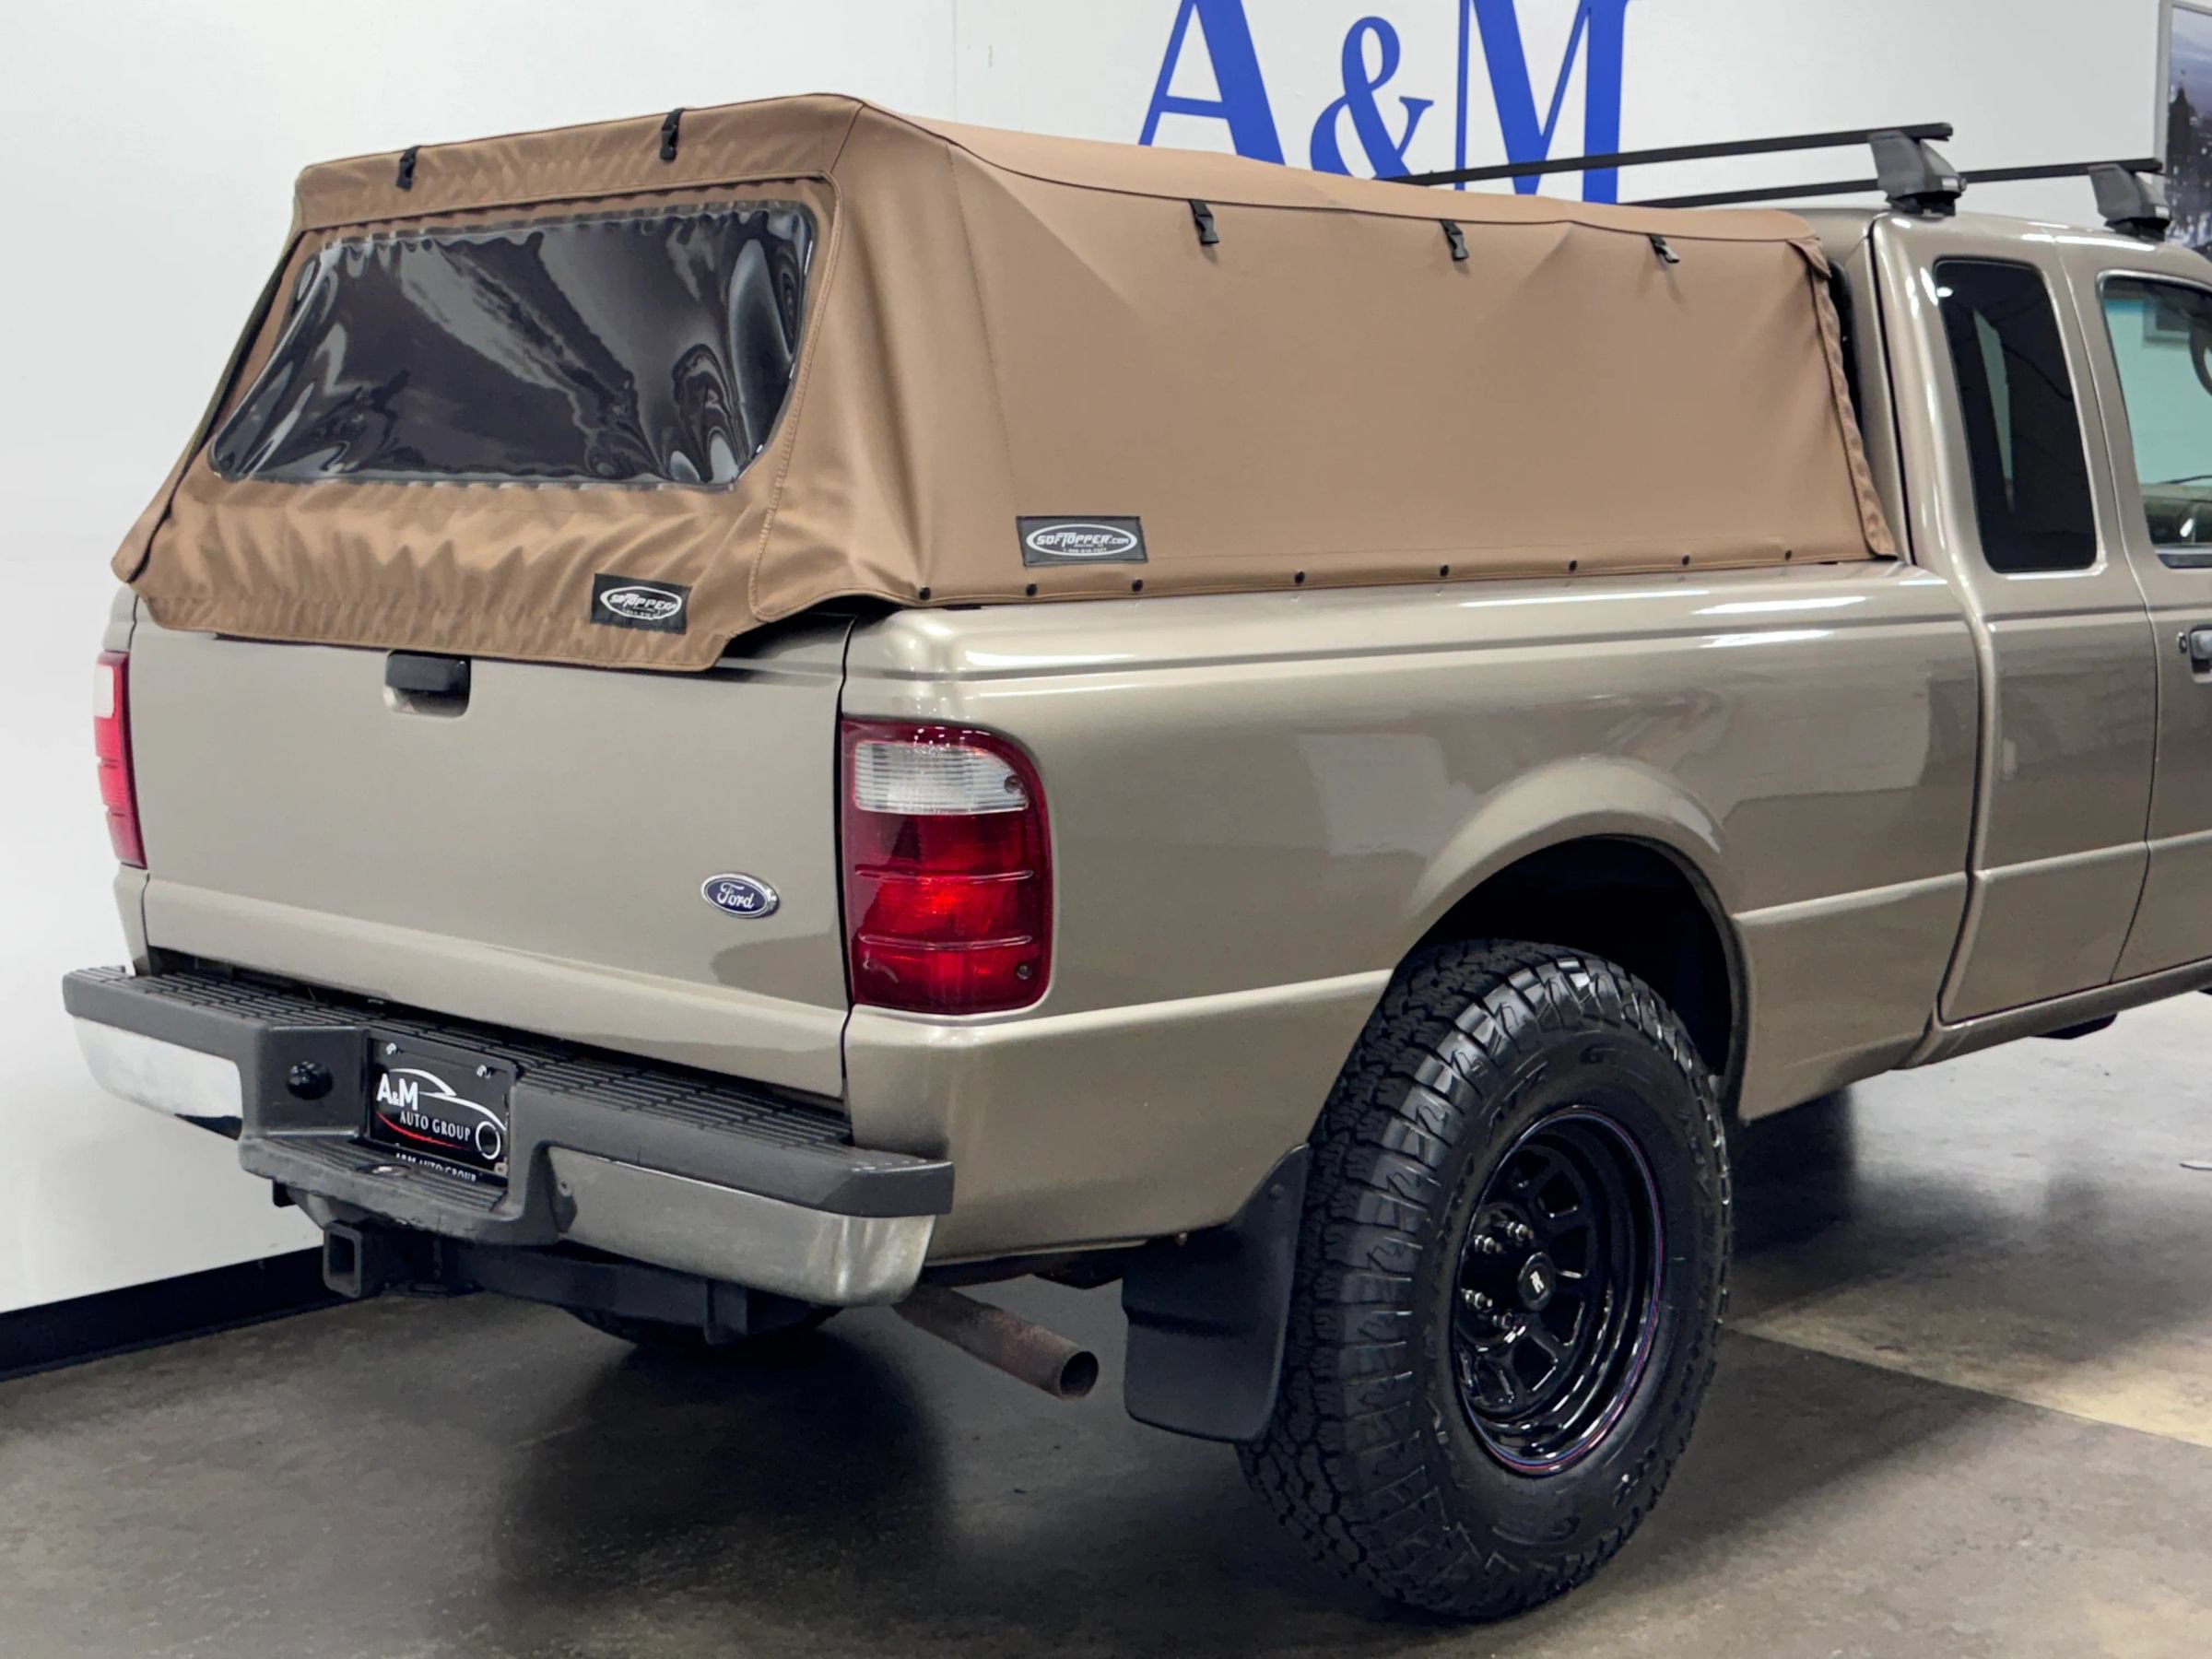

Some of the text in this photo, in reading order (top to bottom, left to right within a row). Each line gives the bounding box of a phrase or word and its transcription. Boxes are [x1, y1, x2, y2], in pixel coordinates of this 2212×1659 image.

[1138, 0, 1632, 204] A&M
[717, 882, 755, 910] Ford
[376, 1073, 418, 1112] A&M
[399, 1111, 471, 1141] AUTO GROUP
